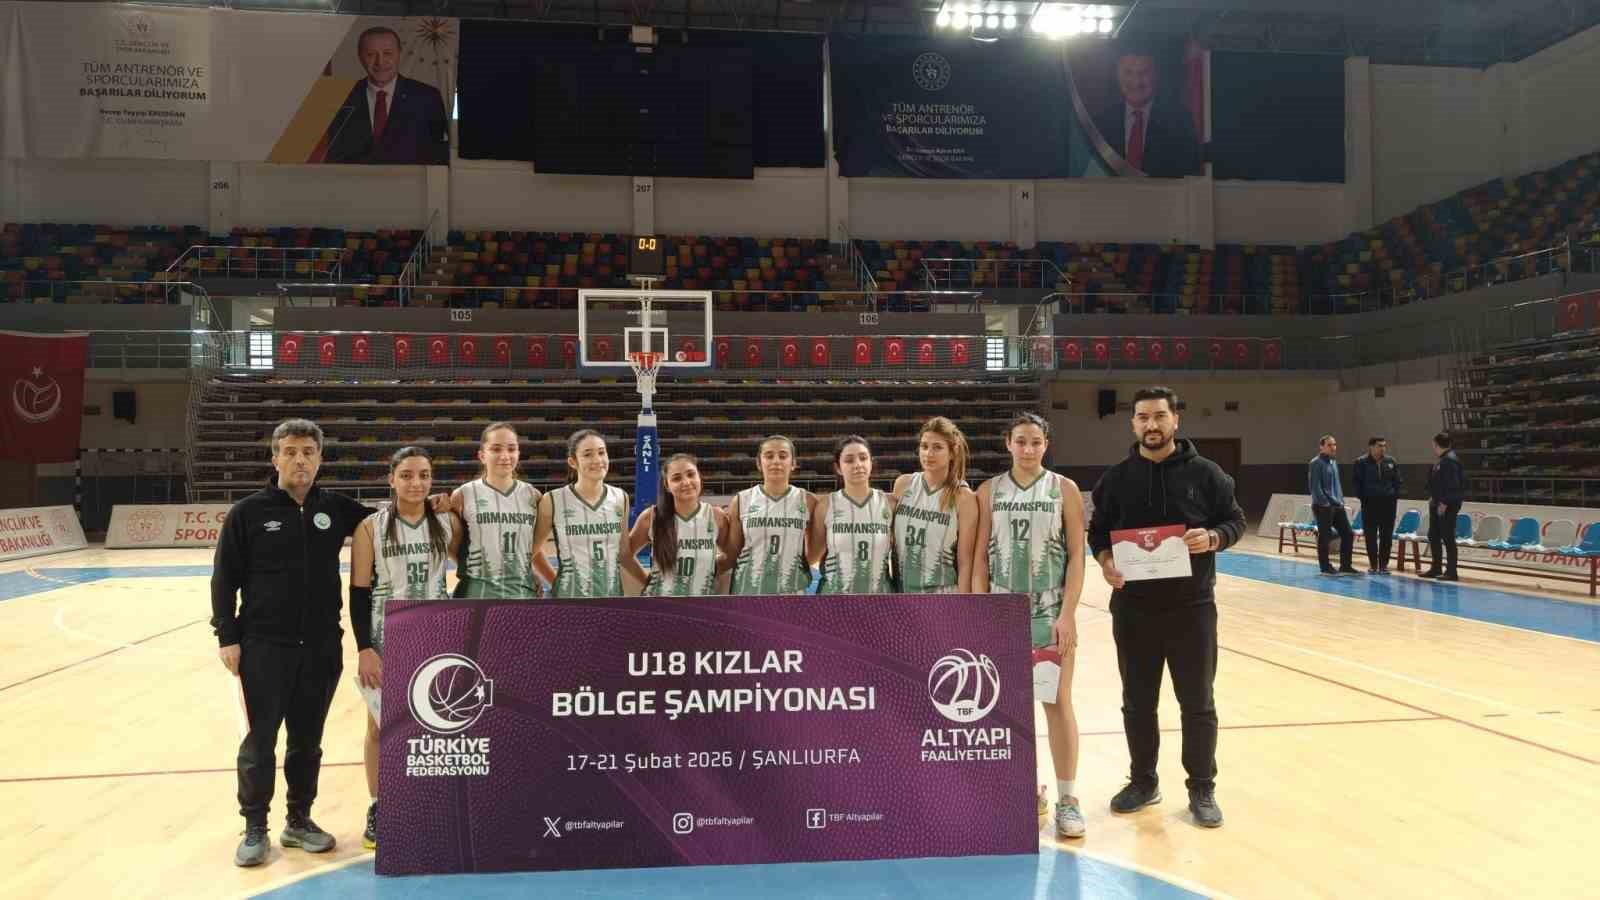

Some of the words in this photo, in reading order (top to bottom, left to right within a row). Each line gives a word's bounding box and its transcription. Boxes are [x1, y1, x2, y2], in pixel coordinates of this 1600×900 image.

[187, 66, 205, 78] VE
[636, 183, 652, 193] 207
[452, 309, 473, 320] 105
[184, 511, 210, 523] T.C.
[175, 528, 218, 541] SPOR
[905, 524, 927, 548] 34
[1011, 518, 1030, 541] 12
[503, 530, 518, 554] 11
[593, 540, 606, 562] 5
[769, 534, 781, 555] 9
[857, 540, 869, 562] 8
[407, 562, 429, 585] 35
[678, 556, 695, 577] 10
[628, 651, 686, 676] U18
[695, 650, 803, 675] KIZLAR
[552, 685, 656, 717] BÖLGE
[664, 682, 876, 720] ŞAMPİYONASI
[956, 707, 974, 716] TBF
[407, 734, 490, 754] TÜRKİYE
[921, 727, 1011, 747] ALTYAPI
[407, 754, 490, 767] BASKETBOL
[567, 754, 618, 771] 17-21
[625, 752, 682, 773] Şubat
[688, 751, 733, 768] 2026
[739, 750, 746, 771] /
[752, 748, 861, 770] ŞANLIURFA
[921, 746, 1011, 761] FAALİYETLERİ
[406, 766, 490, 777] FEDERASYONU
[828, 813, 843, 822] TBF
